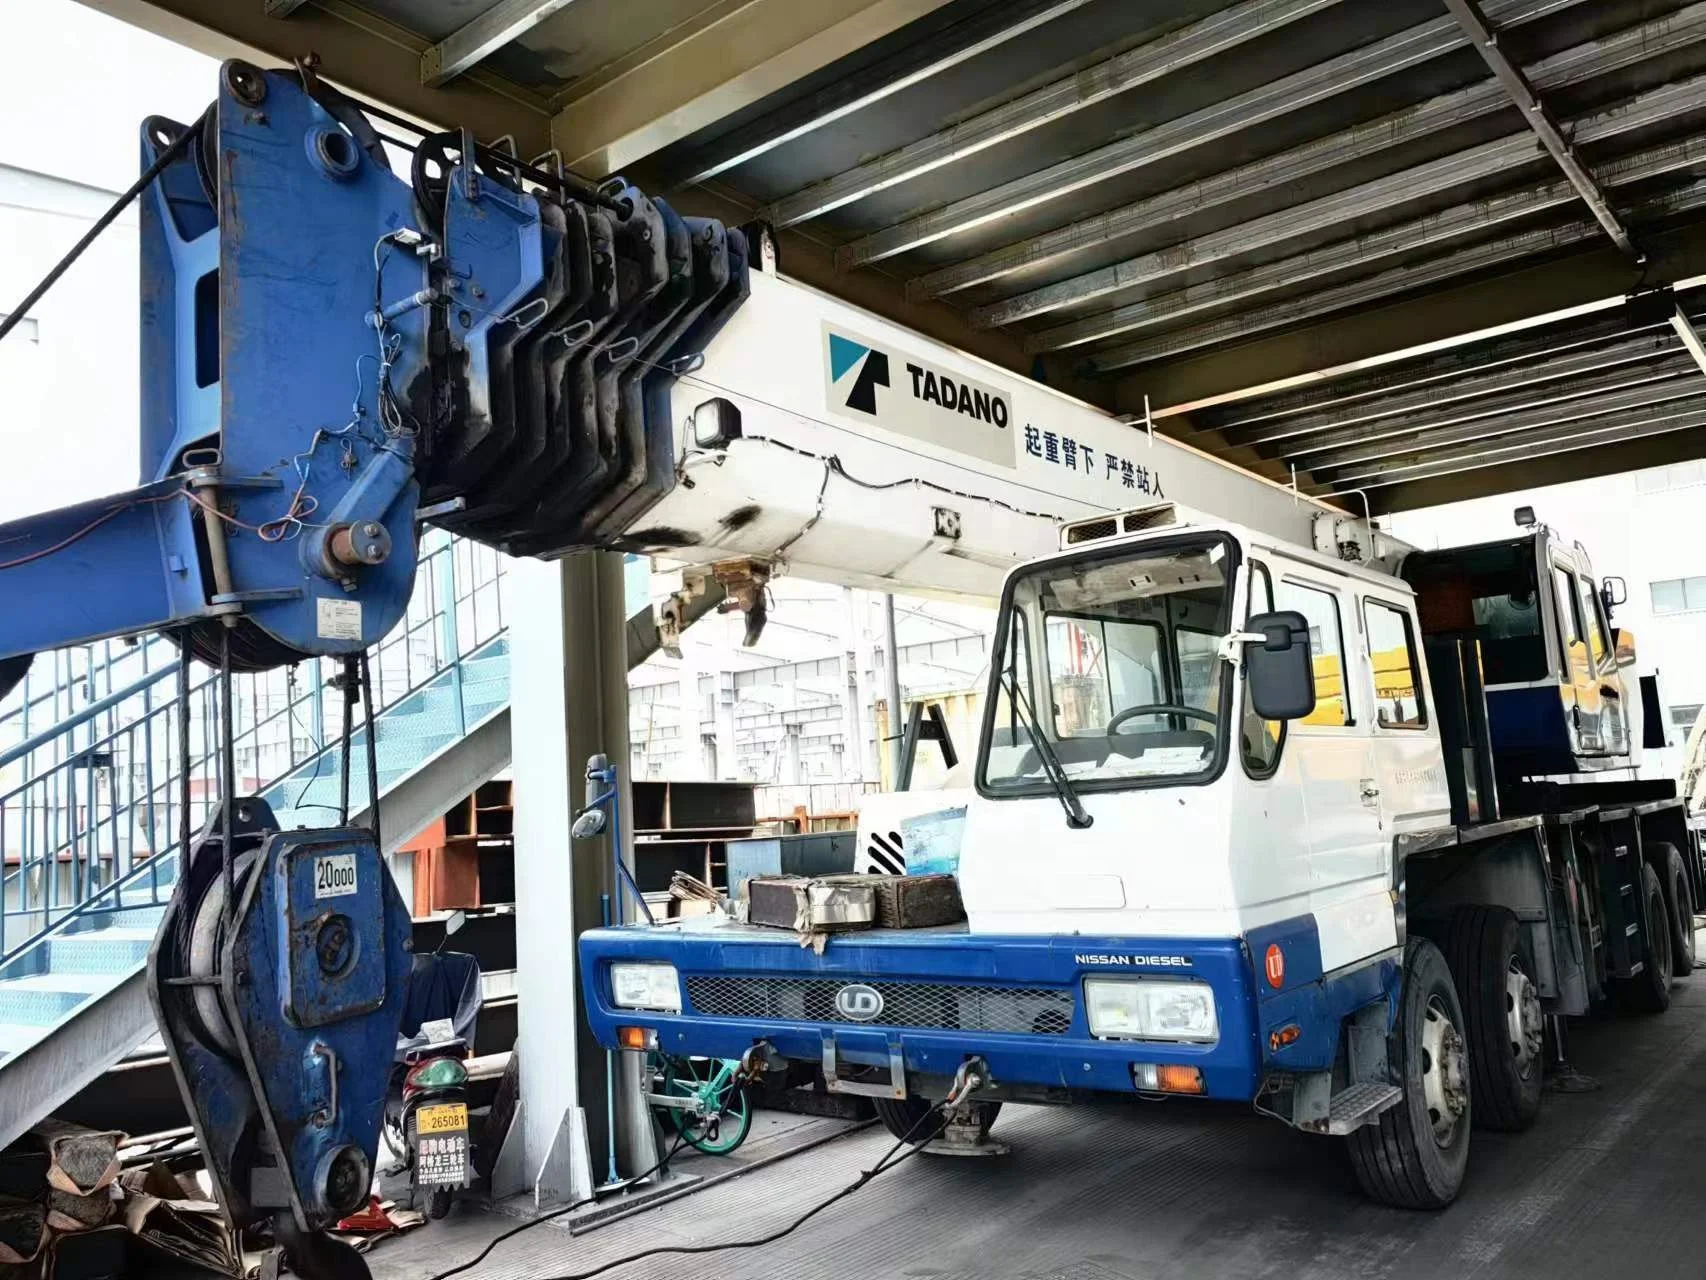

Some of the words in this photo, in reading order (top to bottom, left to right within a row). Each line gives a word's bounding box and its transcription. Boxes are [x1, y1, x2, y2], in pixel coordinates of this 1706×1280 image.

[906, 362, 1008, 429] TADANO
[1024, 423, 1094, 475] 起重臂下
[1104, 452, 1165, 498] 严禁站人
[317, 860, 354, 889] 20000
[1075, 954, 1130, 965] NISSAN
[1135, 956, 1192, 967] DIESEL
[841, 992, 878, 1013] UD
